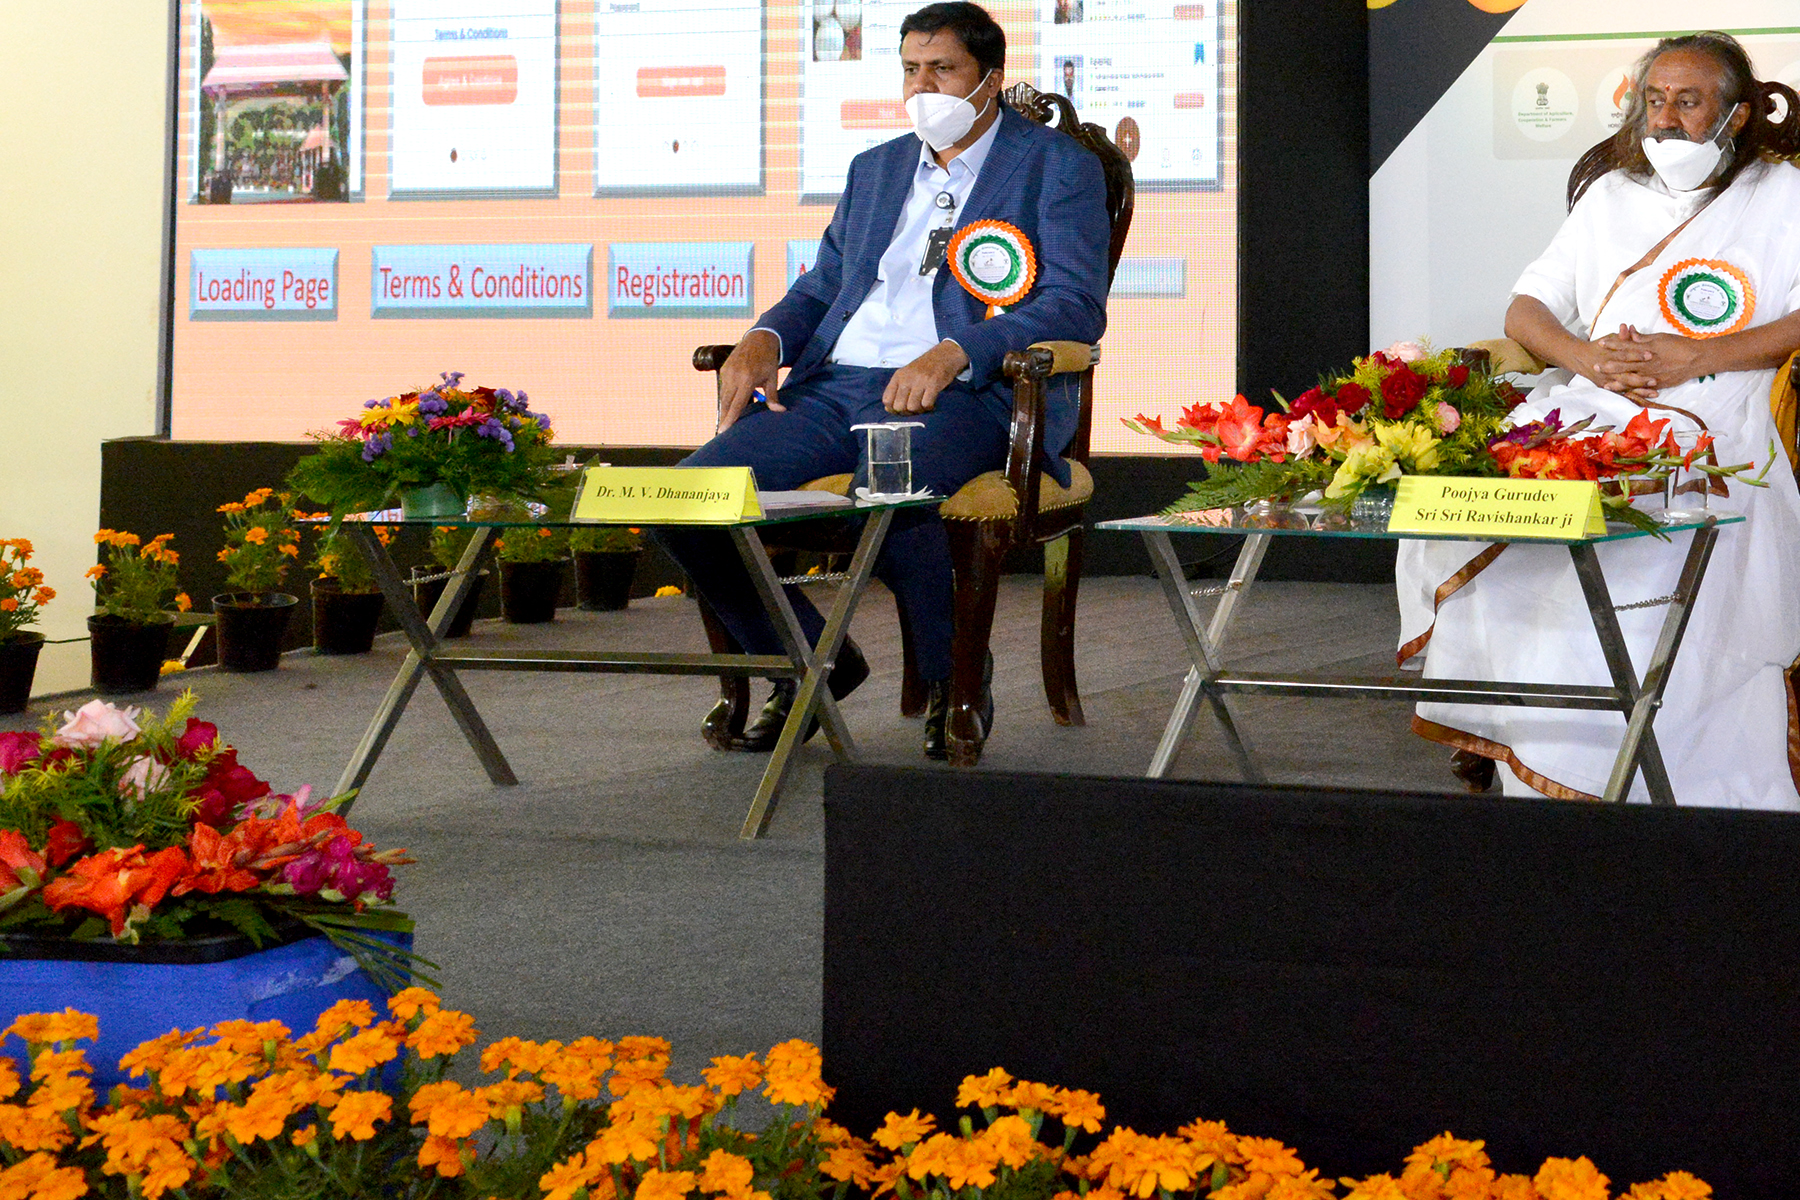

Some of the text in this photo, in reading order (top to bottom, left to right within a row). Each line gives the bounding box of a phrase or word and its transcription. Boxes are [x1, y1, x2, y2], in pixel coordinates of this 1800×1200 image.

[198, 268, 329, 308] Loading Page
[380, 263, 583, 299] Terms & Conditions
[617, 265, 744, 307] Registration
[597, 486, 730, 502] Dr. M. V. Dhananjaya
[1442, 486, 1558, 502] Poojya Gurudev
[1415, 508, 1573, 528] Sri Sri Ravishankar ji
